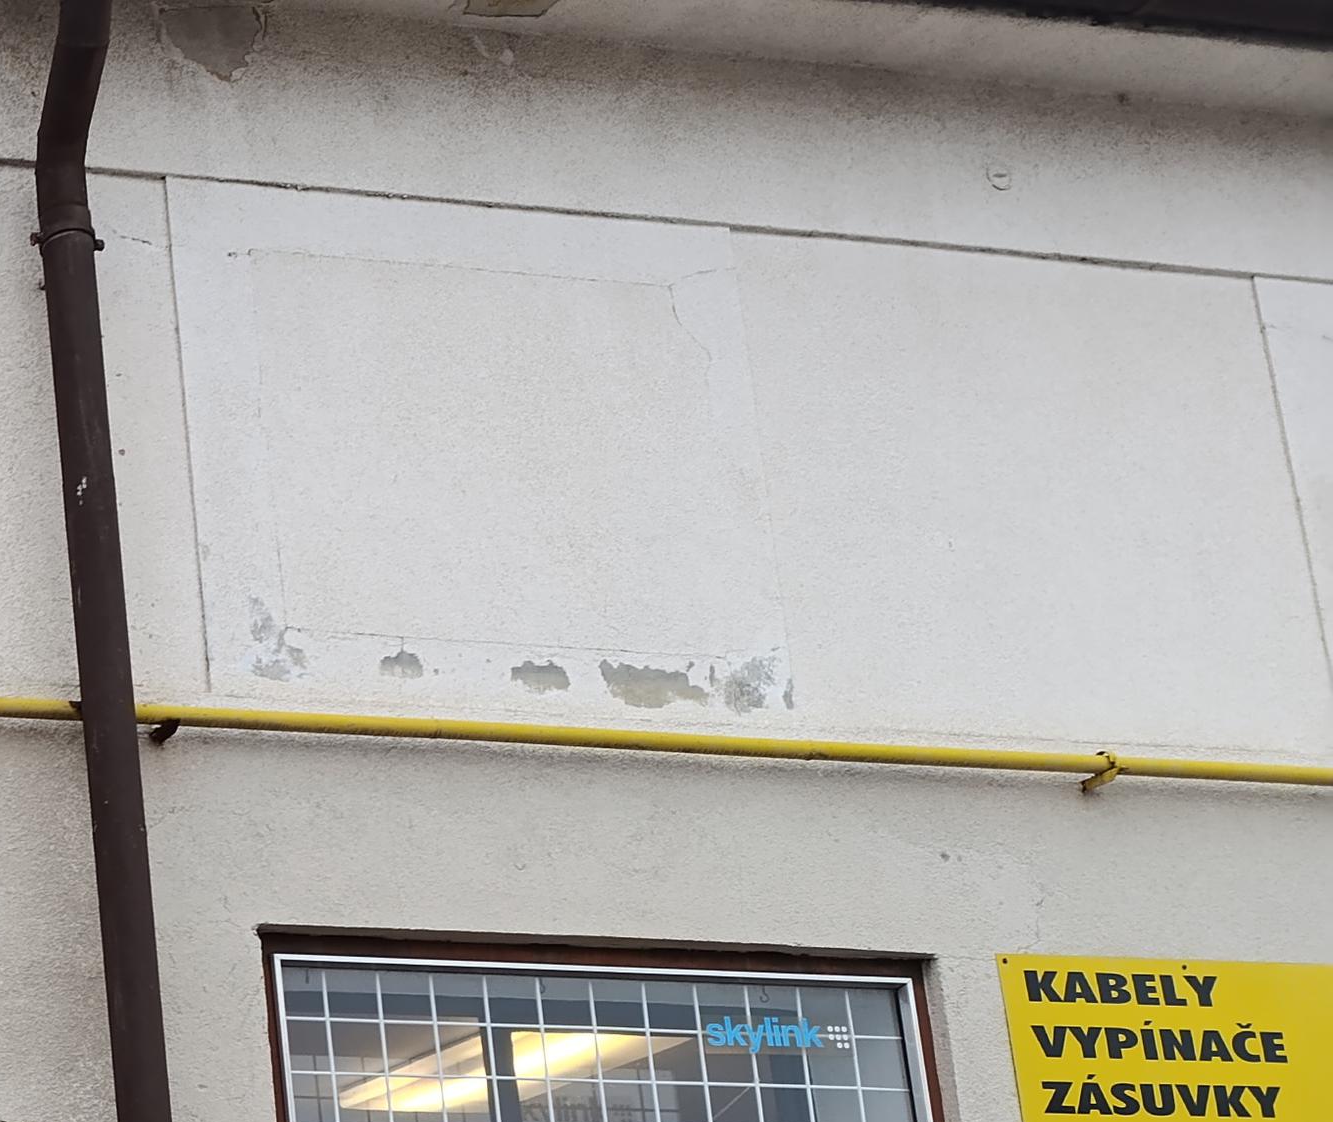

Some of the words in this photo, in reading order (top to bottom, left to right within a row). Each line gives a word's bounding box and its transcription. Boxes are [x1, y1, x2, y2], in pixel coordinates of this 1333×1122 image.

[1024, 969, 1218, 1008] KABELY
[706, 1016, 825, 1054] skylink
[1030, 1020, 1289, 1064] VYPÍNAČE
[1041, 1074, 1281, 1119] ZÁSUVKY
